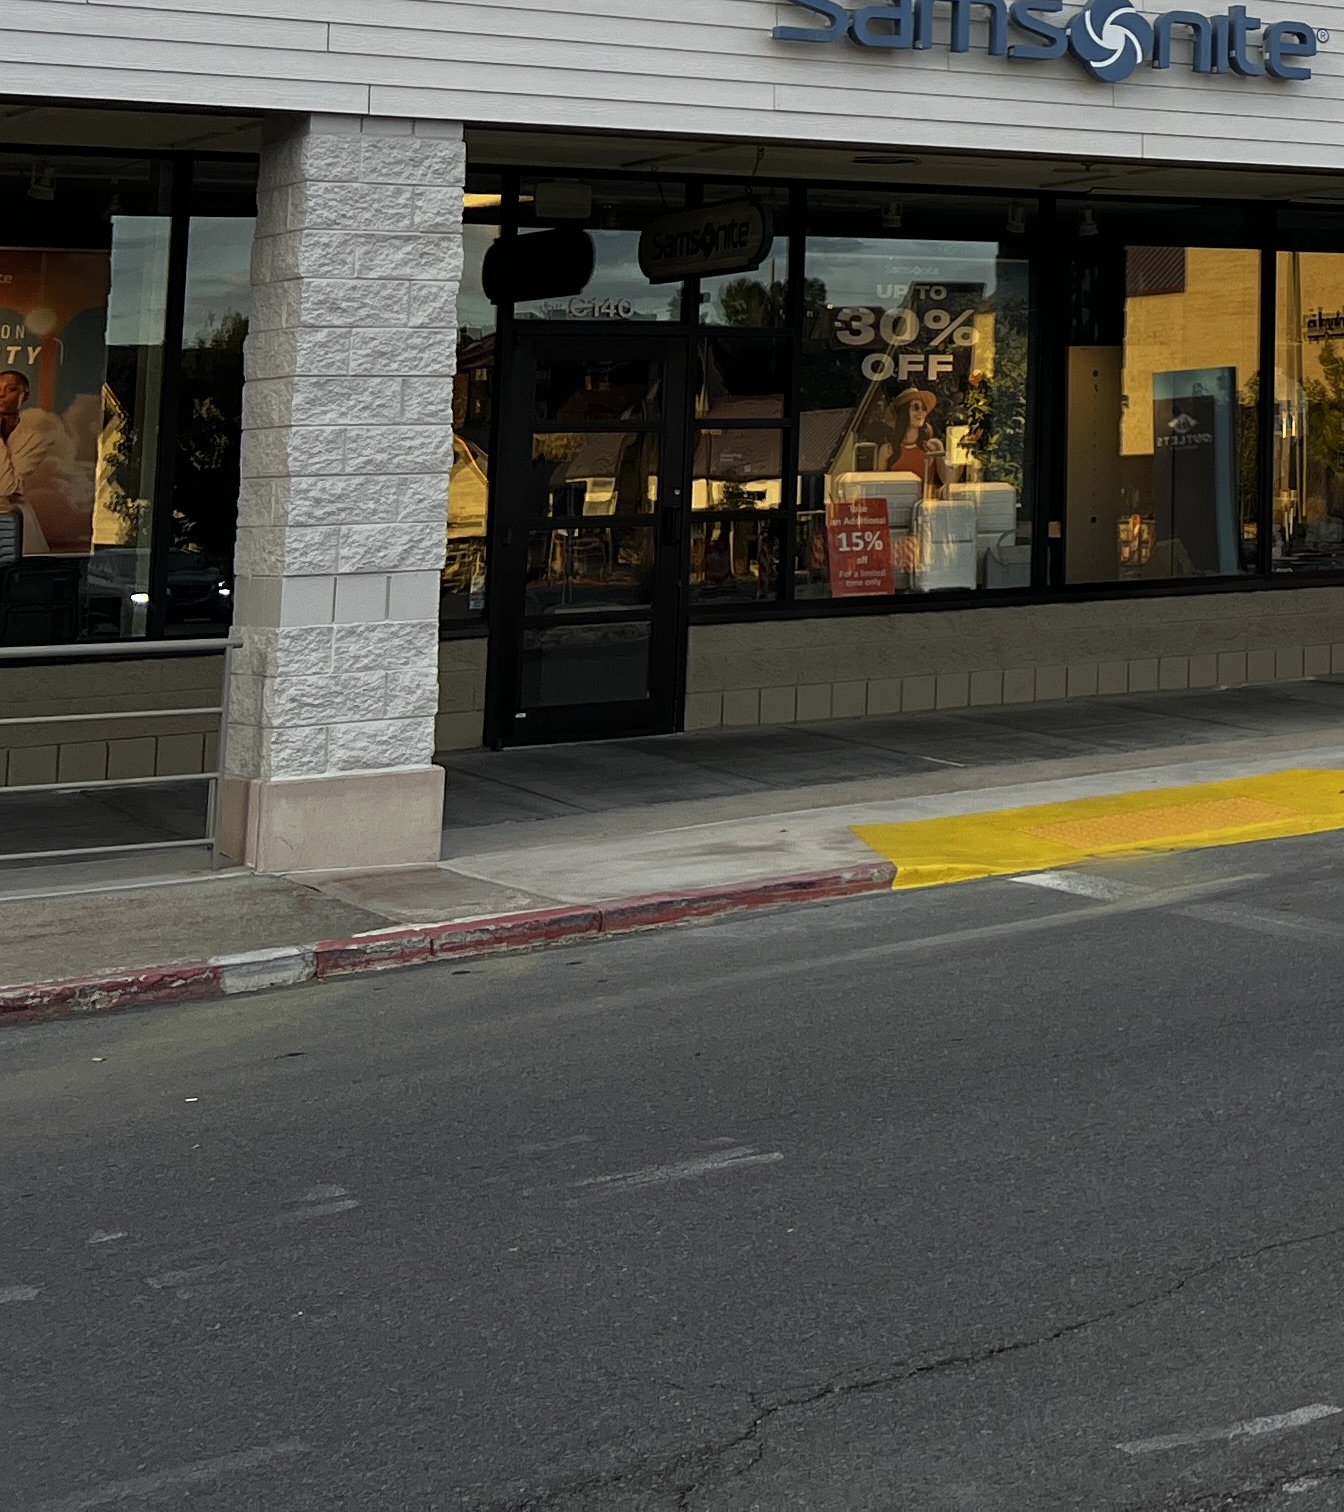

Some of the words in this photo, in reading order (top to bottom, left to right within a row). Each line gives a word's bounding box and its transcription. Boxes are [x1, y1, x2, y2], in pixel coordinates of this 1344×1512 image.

[652, 218, 750, 261] Samsonite
[876, 284, 909, 299] UP
[915, 285, 948, 300] TO
[570, 297, 634, 318] C140
[834, 307, 980, 346] 30%
[861, 353, 954, 382] OFF
[831, 518, 842, 526] an
[843, 516, 887, 525] Additional
[837, 531, 884, 552] 15%
[856, 555, 868, 564] off
[839, 570, 852, 578] For
[860, 569, 887, 577] limited
[845, 579, 864, 587] time
[865, 578, 882, 587] only
